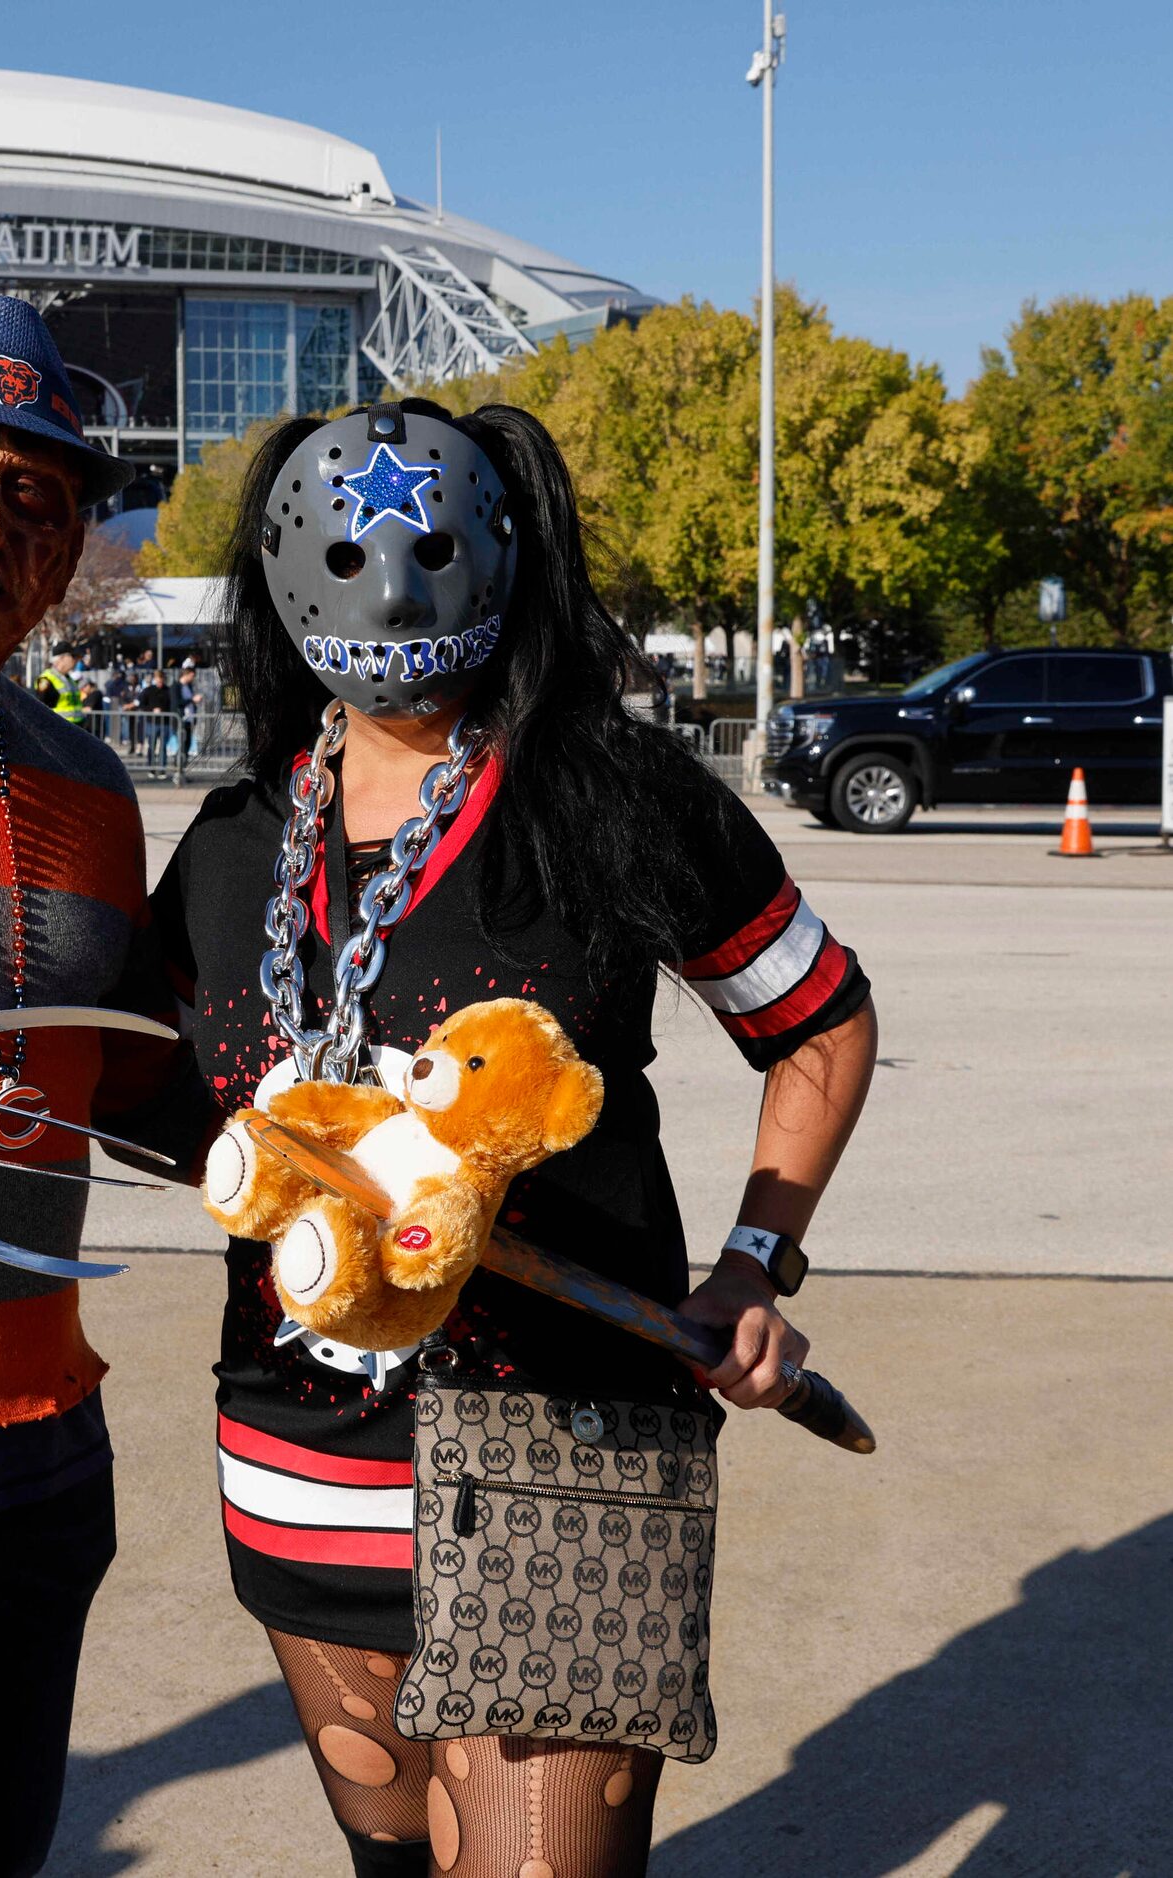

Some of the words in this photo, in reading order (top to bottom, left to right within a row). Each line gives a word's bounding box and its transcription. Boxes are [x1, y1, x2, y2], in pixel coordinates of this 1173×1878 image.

[304, 615, 502, 683] COWBOYS
[458, 1400, 484, 1414] MK
[504, 1402, 529, 1417] MK
[632, 1413, 656, 1427] MK
[435, 1448, 462, 1463] MK
[483, 1447, 510, 1463] MK
[530, 1448, 556, 1464] MK
[573, 1453, 600, 1468] MK
[617, 1454, 643, 1470] MK
[687, 1466, 708, 1485] MK
[508, 1510, 536, 1527] MK
[556, 1515, 584, 1533] MK
[602, 1519, 626, 1537] MK
[646, 1523, 668, 1541] MK
[432, 1549, 460, 1568] MK
[481, 1555, 510, 1575] MK
[528, 1561, 557, 1580] MK
[576, 1566, 603, 1585] MK
[622, 1571, 647, 1588] MK
[665, 1573, 685, 1590] MK
[454, 1602, 482, 1621] MK
[503, 1607, 530, 1627] MK
[550, 1613, 578, 1632] MK
[597, 1618, 622, 1637] MK
[640, 1621, 666, 1639] MK
[425, 1648, 453, 1668] MK
[474, 1655, 502, 1674] MK
[524, 1661, 551, 1680] MK
[571, 1666, 597, 1685] MK
[616, 1670, 642, 1688] MK
[661, 1672, 682, 1689] MK
[440, 1699, 469, 1718] MK
[490, 1706, 519, 1723] MK
[540, 1711, 566, 1725] MK
[583, 1716, 612, 1730] MK
[628, 1719, 656, 1733] MK
[673, 1720, 693, 1737] MK
